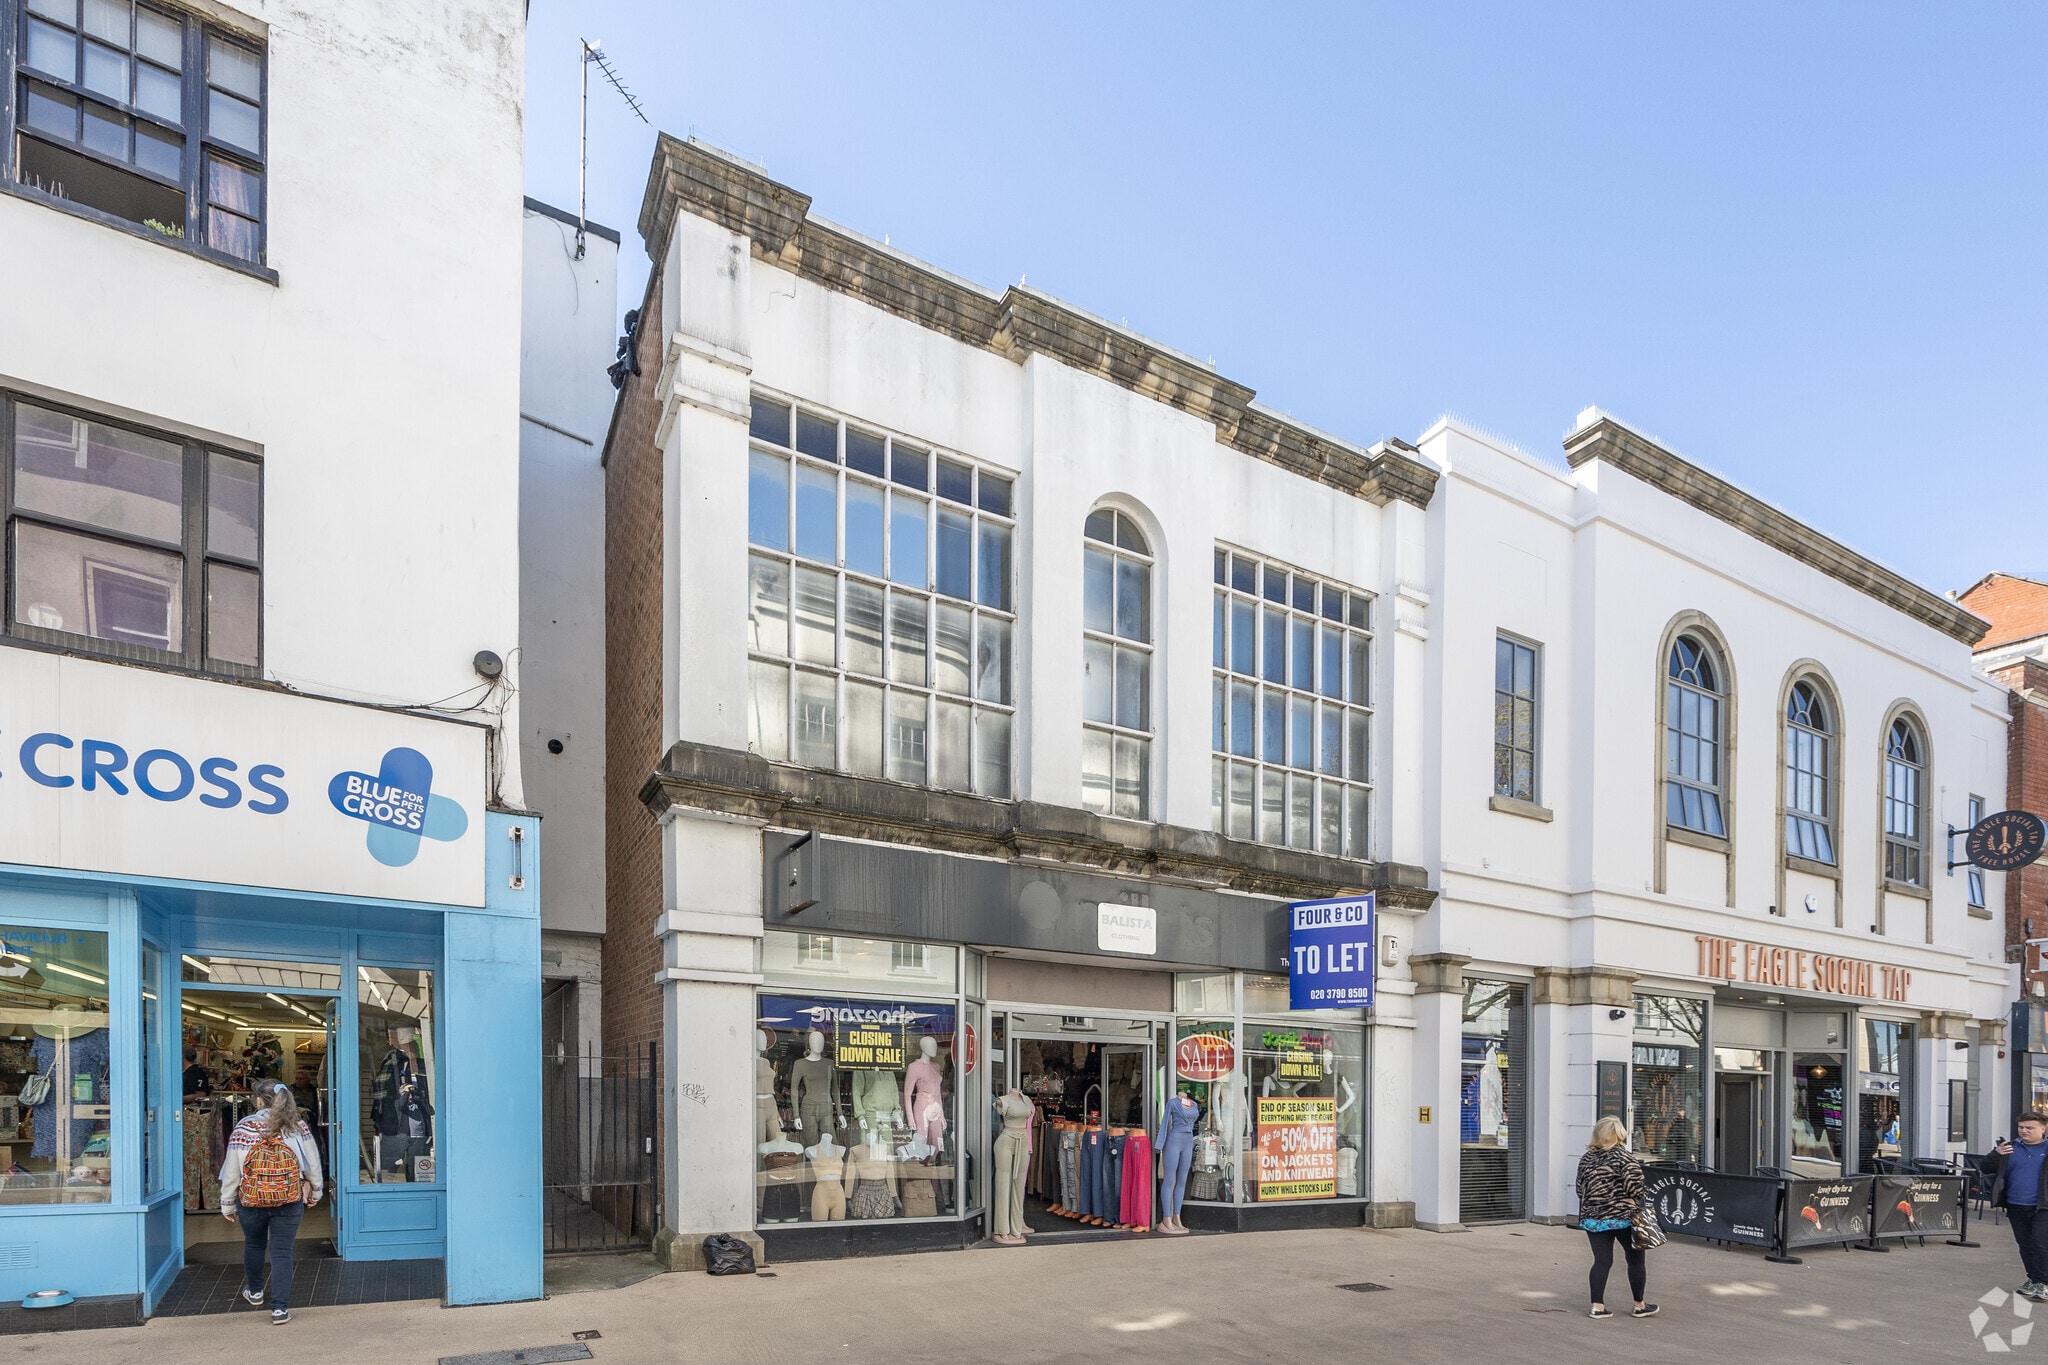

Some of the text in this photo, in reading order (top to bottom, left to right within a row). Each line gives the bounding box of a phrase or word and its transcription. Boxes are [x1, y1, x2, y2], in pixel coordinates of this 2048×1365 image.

[19, 732, 289, 815] CROSS
[346, 775, 402, 806] BLUE
[403, 791, 424, 804] FOR
[343, 794, 421, 830] CROSS
[401, 799, 424, 814] PETS
[1975, 817, 2001, 837] EAGLE
[2005, 815, 2034, 830] SOCIAL
[1977, 848, 2031, 866] FREE HOUSE
[1102, 914, 1153, 930] BALISTA
[1298, 905, 1363, 926] FOUR & CO
[1111, 933, 1140, 941] CLOTHING
[1294, 945, 1320, 975] TO
[1327, 942, 1368, 973] LET
[1695, 935, 1912, 1002] THE EAGLE SOCIAL TAP
[1310, 987, 1368, 1000] 020 3790 8500
[849, 1030, 892, 1046] CLOSING
[840, 1046, 902, 1064] DOWN SALE
[1180, 1044, 1227, 1072] SALE
[1286, 1050, 1314, 1063] CLOSING
[1281, 1063, 1320, 1077] DOWN SALE
[1261, 1102, 1333, 1112] END OF SEASON SALE
[1420, 1107, 1429, 1121] H
[1261, 1114, 1295, 1122] EVERYTHING
[1281, 1126, 1308, 1153] 50%
[1310, 1126, 1334, 1151] OFF
[1261, 1153, 1333, 1168] ON JACKETS
[1261, 1167, 1334, 1182] AND KNITWEAR
[1261, 1182, 1333, 1196] HURRY WHILE STOCKS LAST
[1650, 1176, 1676, 1195] EAGLE
[1680, 1177, 1712, 1202] SOCIAL
[1703, 1206, 1715, 1223] TAP
[1819, 1196, 1850, 1208] GUINNESS
[1913, 1191, 1940, 1203] GUINNESS
[1732, 1226, 1764, 1238] GUINNESS
